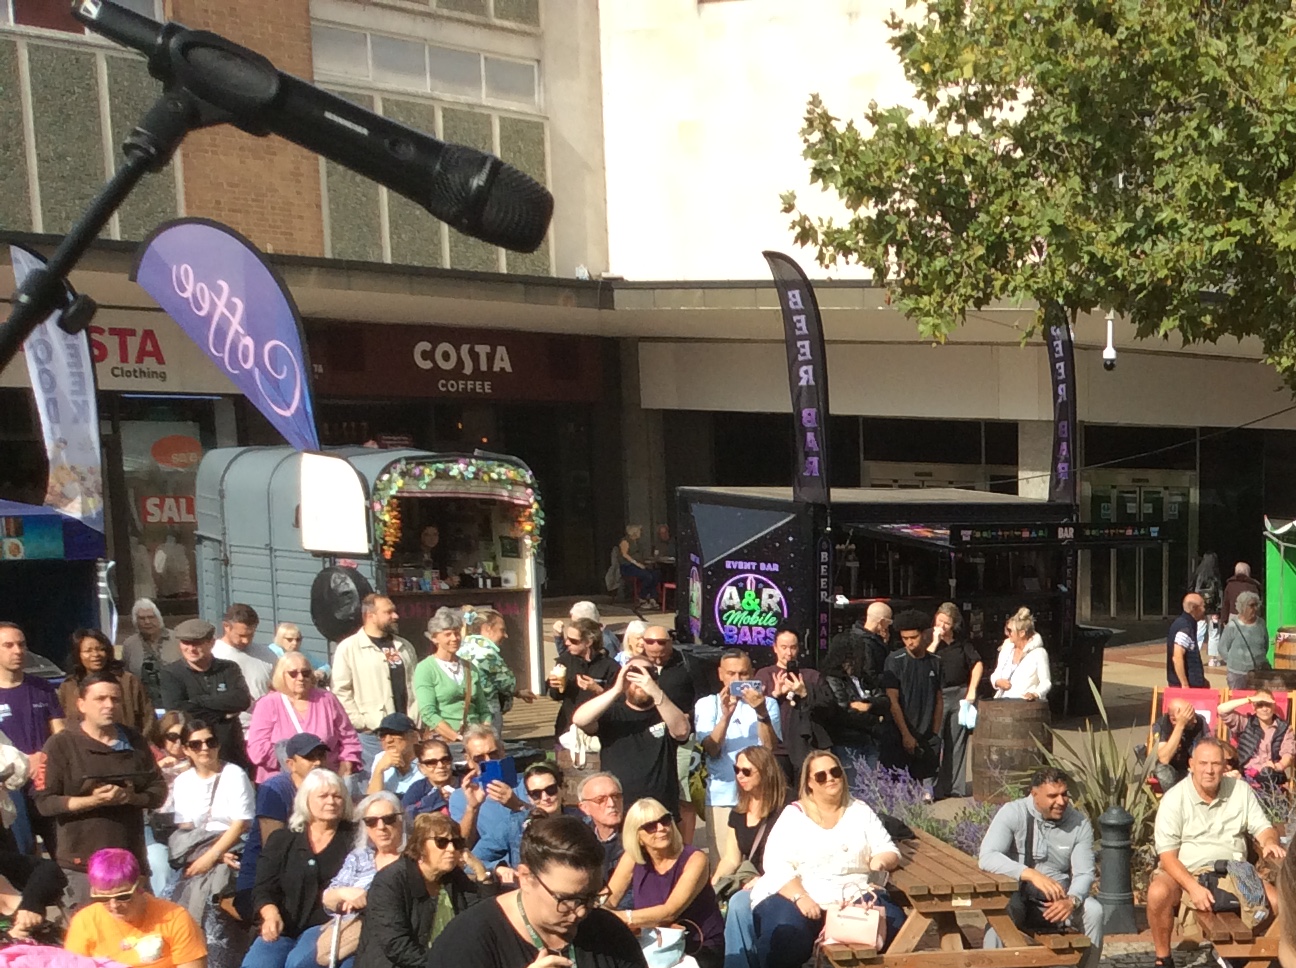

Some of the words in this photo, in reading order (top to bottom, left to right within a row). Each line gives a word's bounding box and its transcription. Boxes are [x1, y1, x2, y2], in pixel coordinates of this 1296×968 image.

[413, 341, 513, 376] COSTA
[111, 366, 167, 382] Clothing
[438, 379, 492, 394] COFFEE
[146, 497, 196, 523] SAL
[1058, 527, 1075, 539] BAR
[725, 560, 757, 571] EVENT
[760, 562, 780, 572] BAR
[820, 551, 829, 602] BEER
[722, 610, 778, 627] Mobile
[724, 625, 777, 646] BARS
[819, 613, 828, 650] BAR
